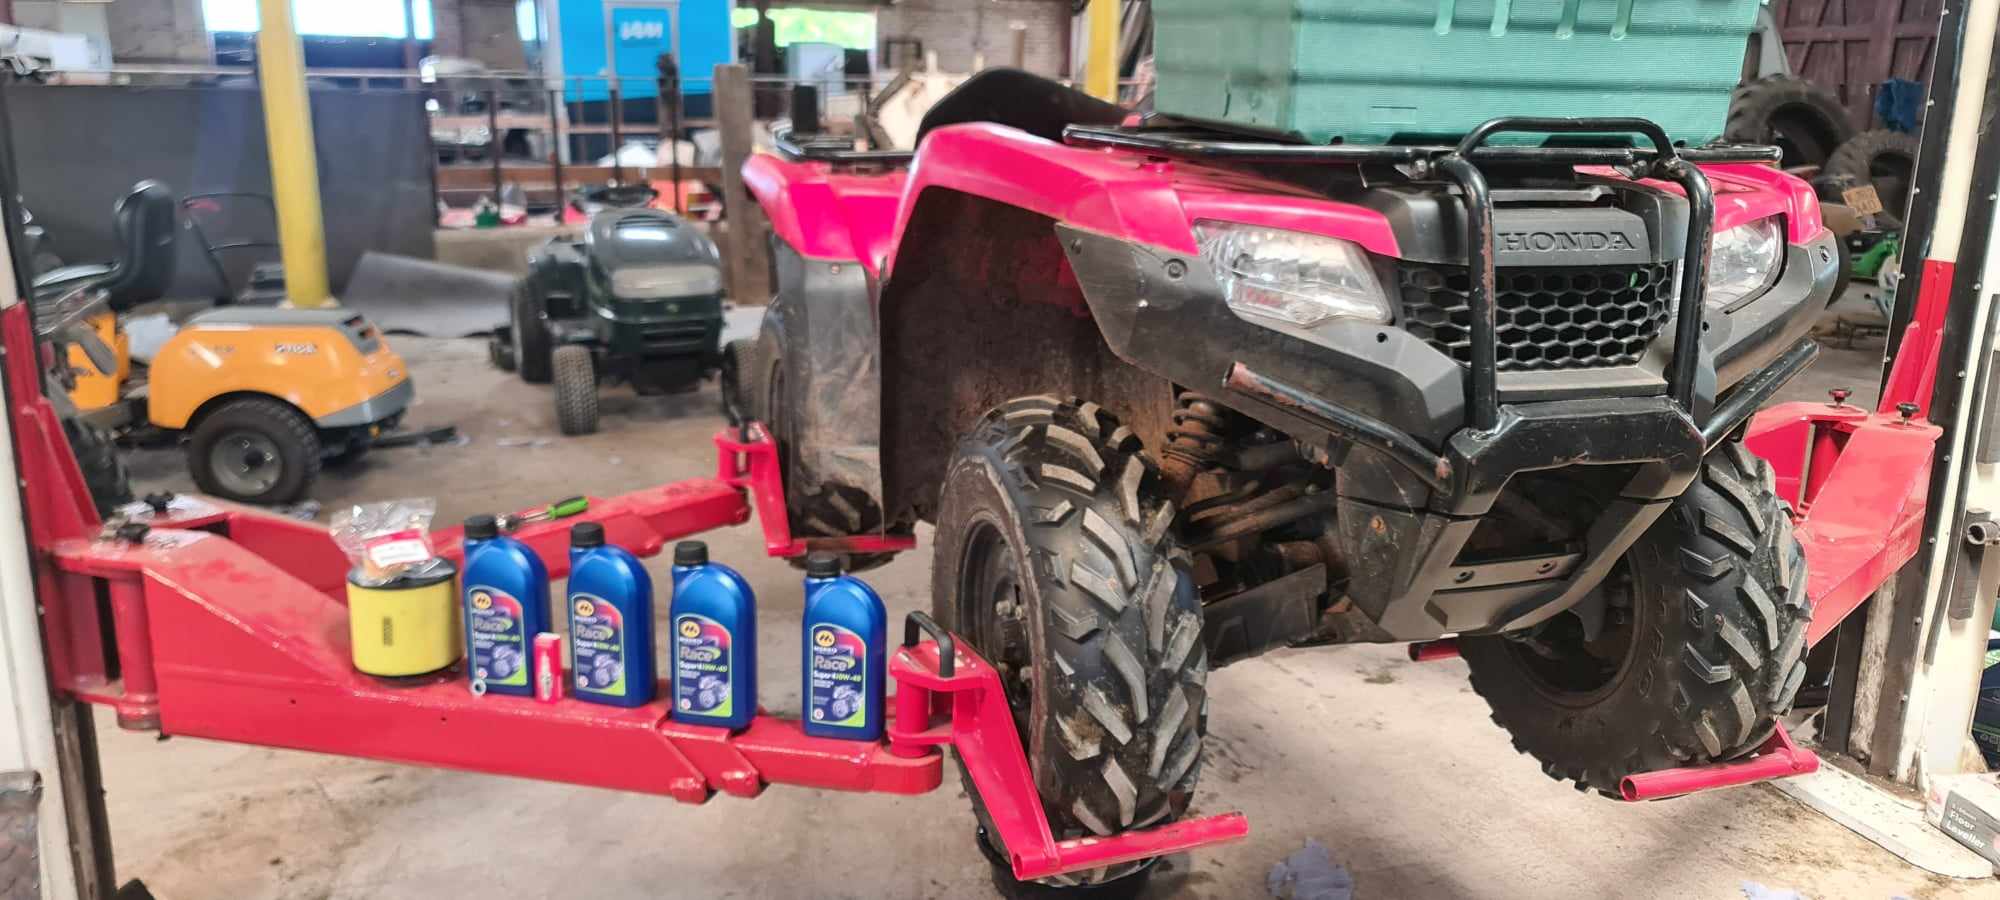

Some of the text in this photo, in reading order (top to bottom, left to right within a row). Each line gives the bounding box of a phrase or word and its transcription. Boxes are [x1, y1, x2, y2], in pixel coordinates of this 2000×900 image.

[1497, 231, 1637, 252] HONDA
[576, 624, 608, 641] Race
[680, 646, 713, 662] Race
[814, 655, 848, 671] Race
[813, 670, 832, 680] Super
[1950, 811, 1976, 831] Floor
